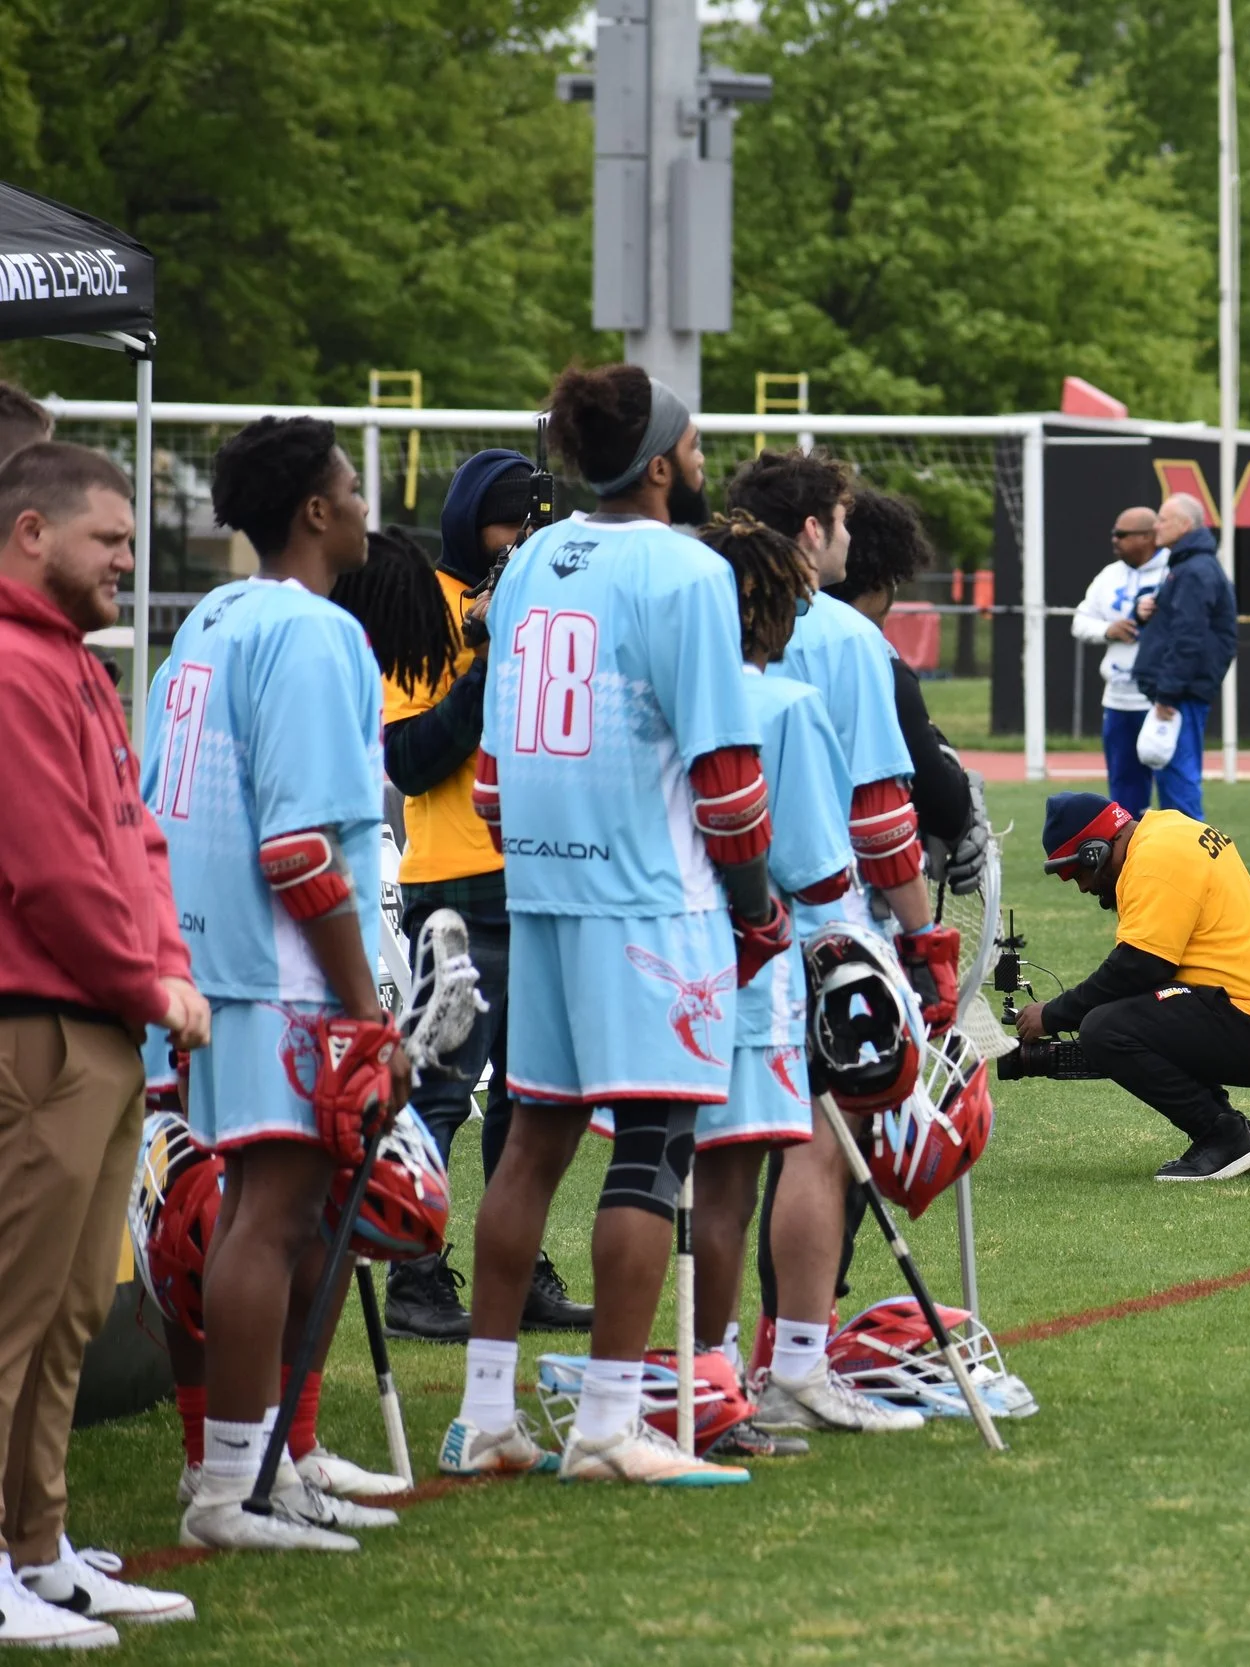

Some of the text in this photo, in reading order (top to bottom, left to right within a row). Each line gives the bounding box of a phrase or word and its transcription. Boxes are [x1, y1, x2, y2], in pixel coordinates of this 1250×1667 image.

[37, 248, 128, 298] LEAGUE
[155, 664, 212, 819] 17
[513, 608, 597, 757] 18
